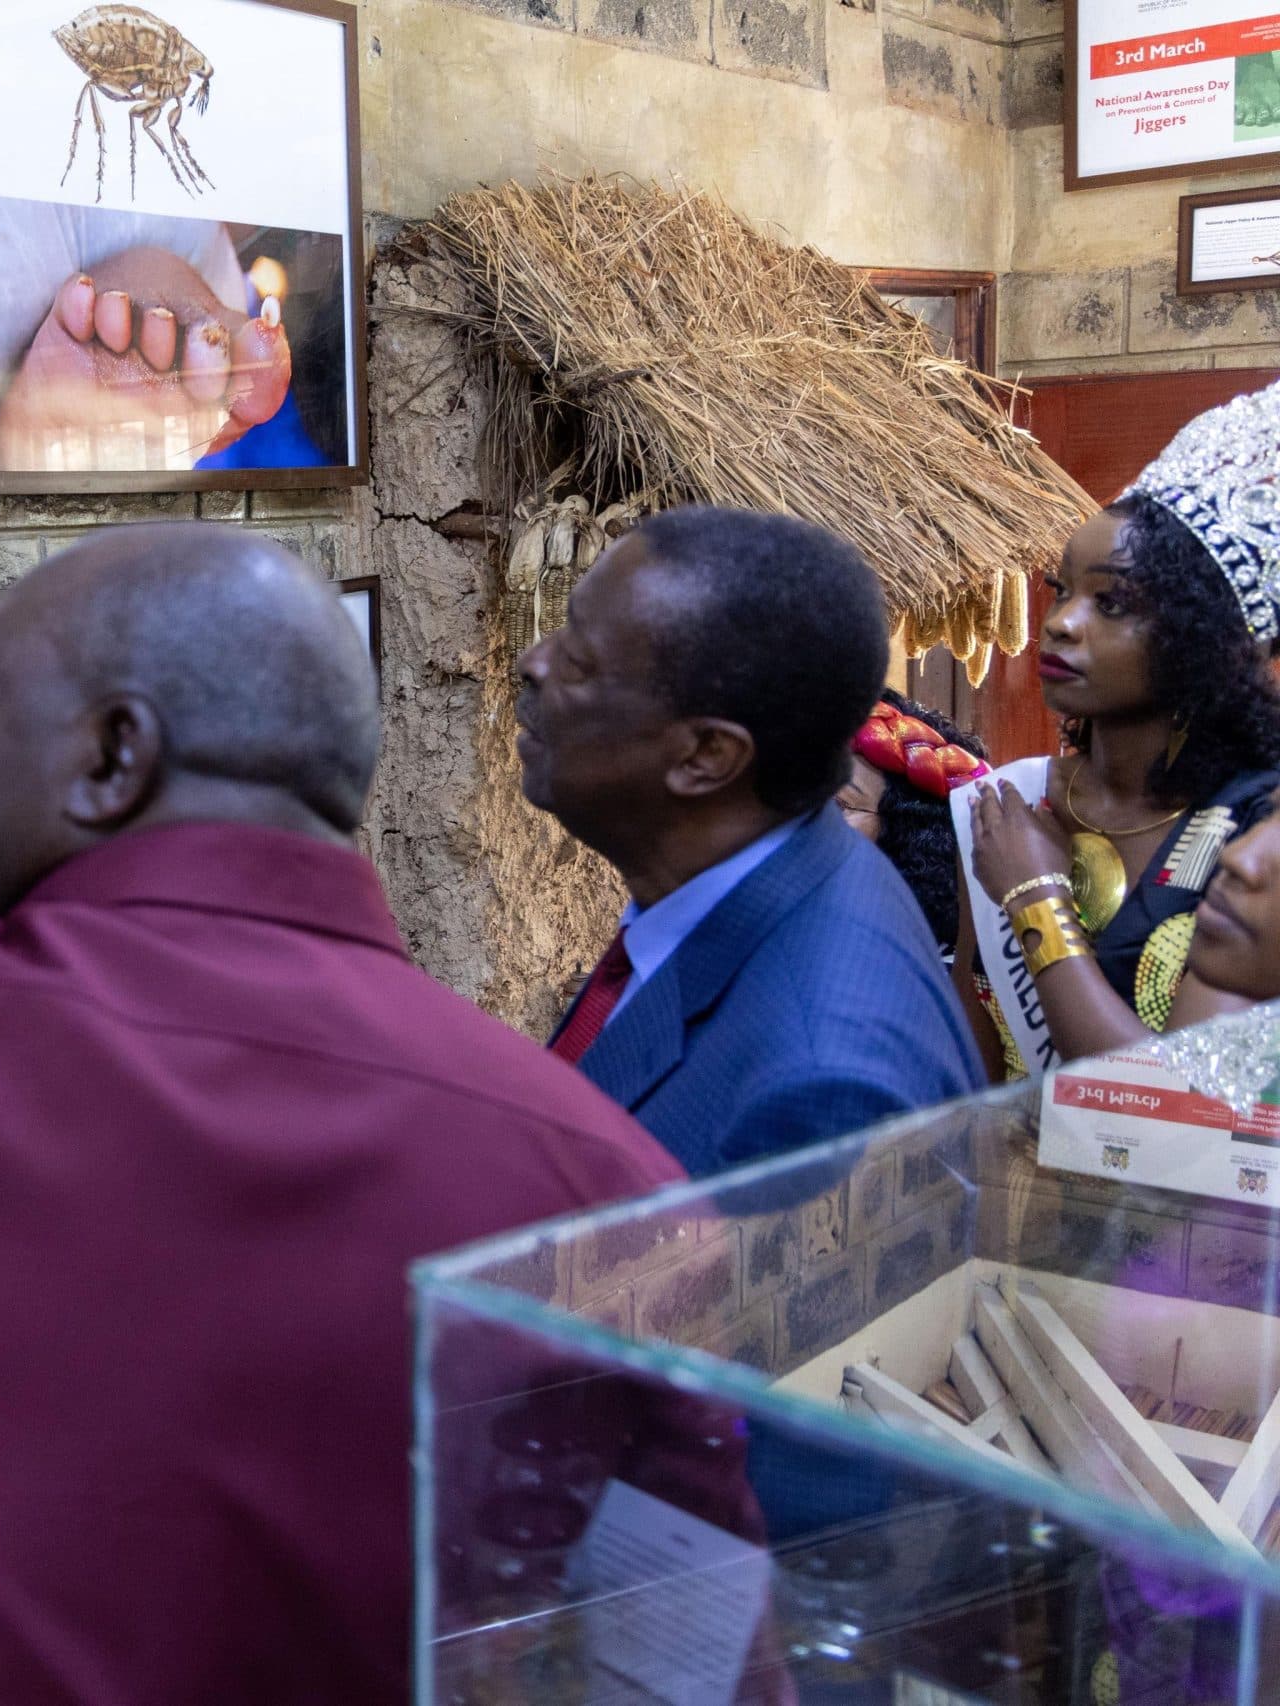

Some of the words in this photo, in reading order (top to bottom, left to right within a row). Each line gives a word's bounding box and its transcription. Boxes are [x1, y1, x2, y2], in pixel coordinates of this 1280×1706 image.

[1115, 47, 1144, 66] 3rd
[1150, 37, 1206, 60] March
[1095, 92, 1142, 108] National
[1144, 84, 1204, 101] Awareness
[1208, 80, 1230, 91] Day
[1118, 104, 1162, 116] Prevention
[1164, 101, 1171, 109] &
[1173, 97, 1205, 108] Control
[1208, 95, 1217, 103] of
[1133, 115, 1187, 134] Jiggers
